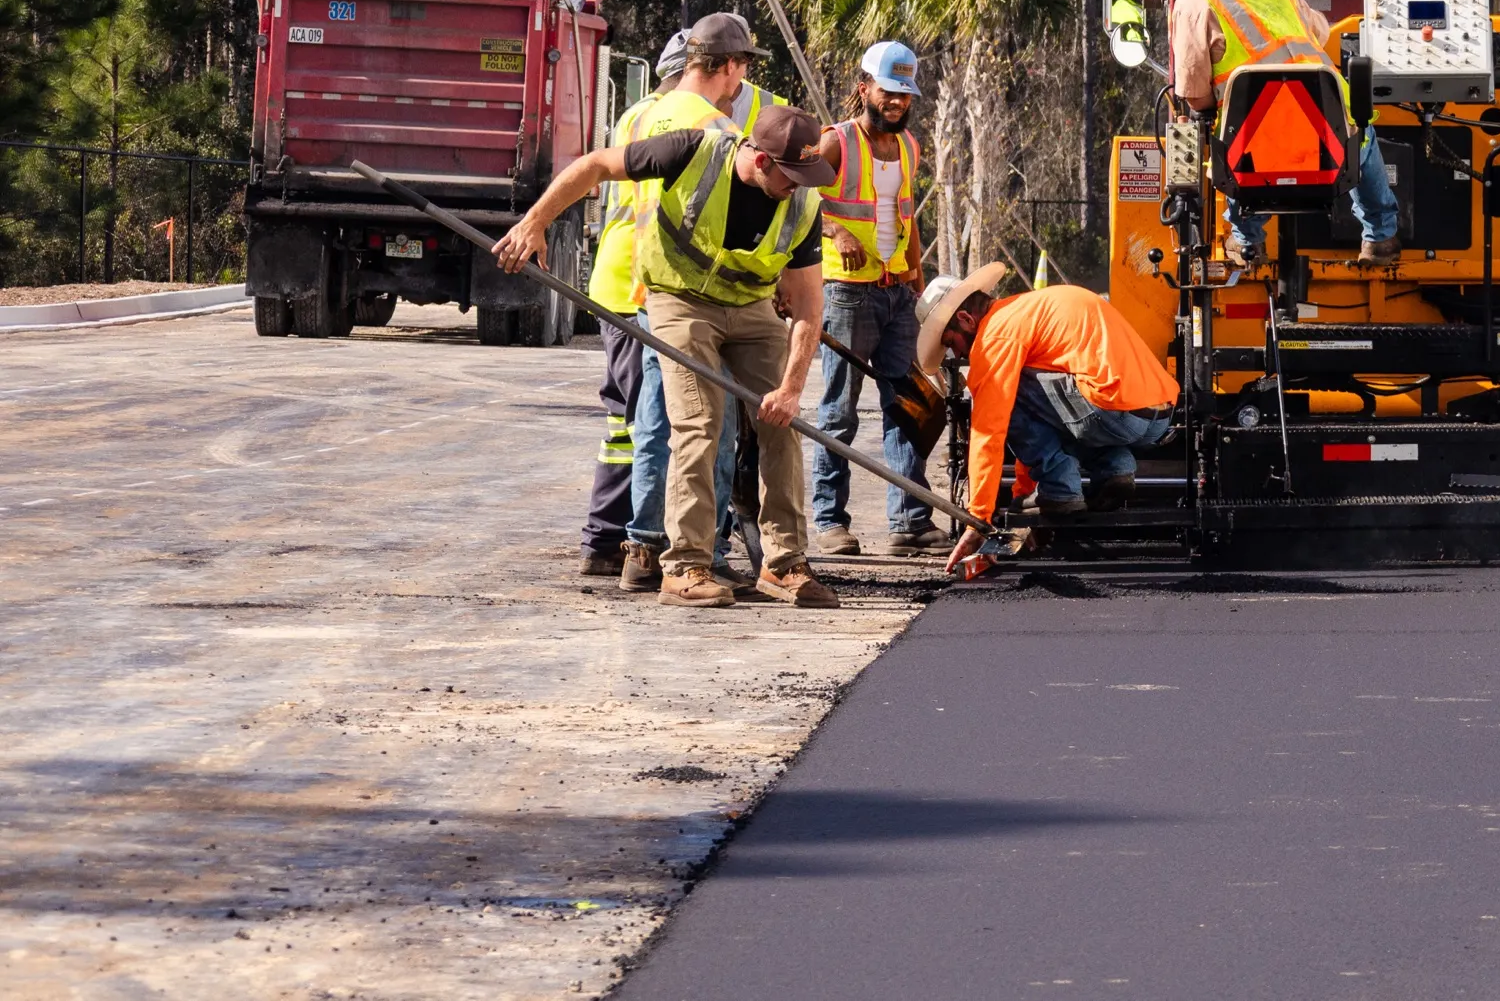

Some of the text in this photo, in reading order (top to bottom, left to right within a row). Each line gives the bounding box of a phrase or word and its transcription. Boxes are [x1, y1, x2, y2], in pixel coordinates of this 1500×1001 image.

[329, 1, 356, 20] 321
[290, 29, 323, 42] ACA 019
[501, 55, 518, 63] NOT
[485, 62, 519, 70] FOLLOW
